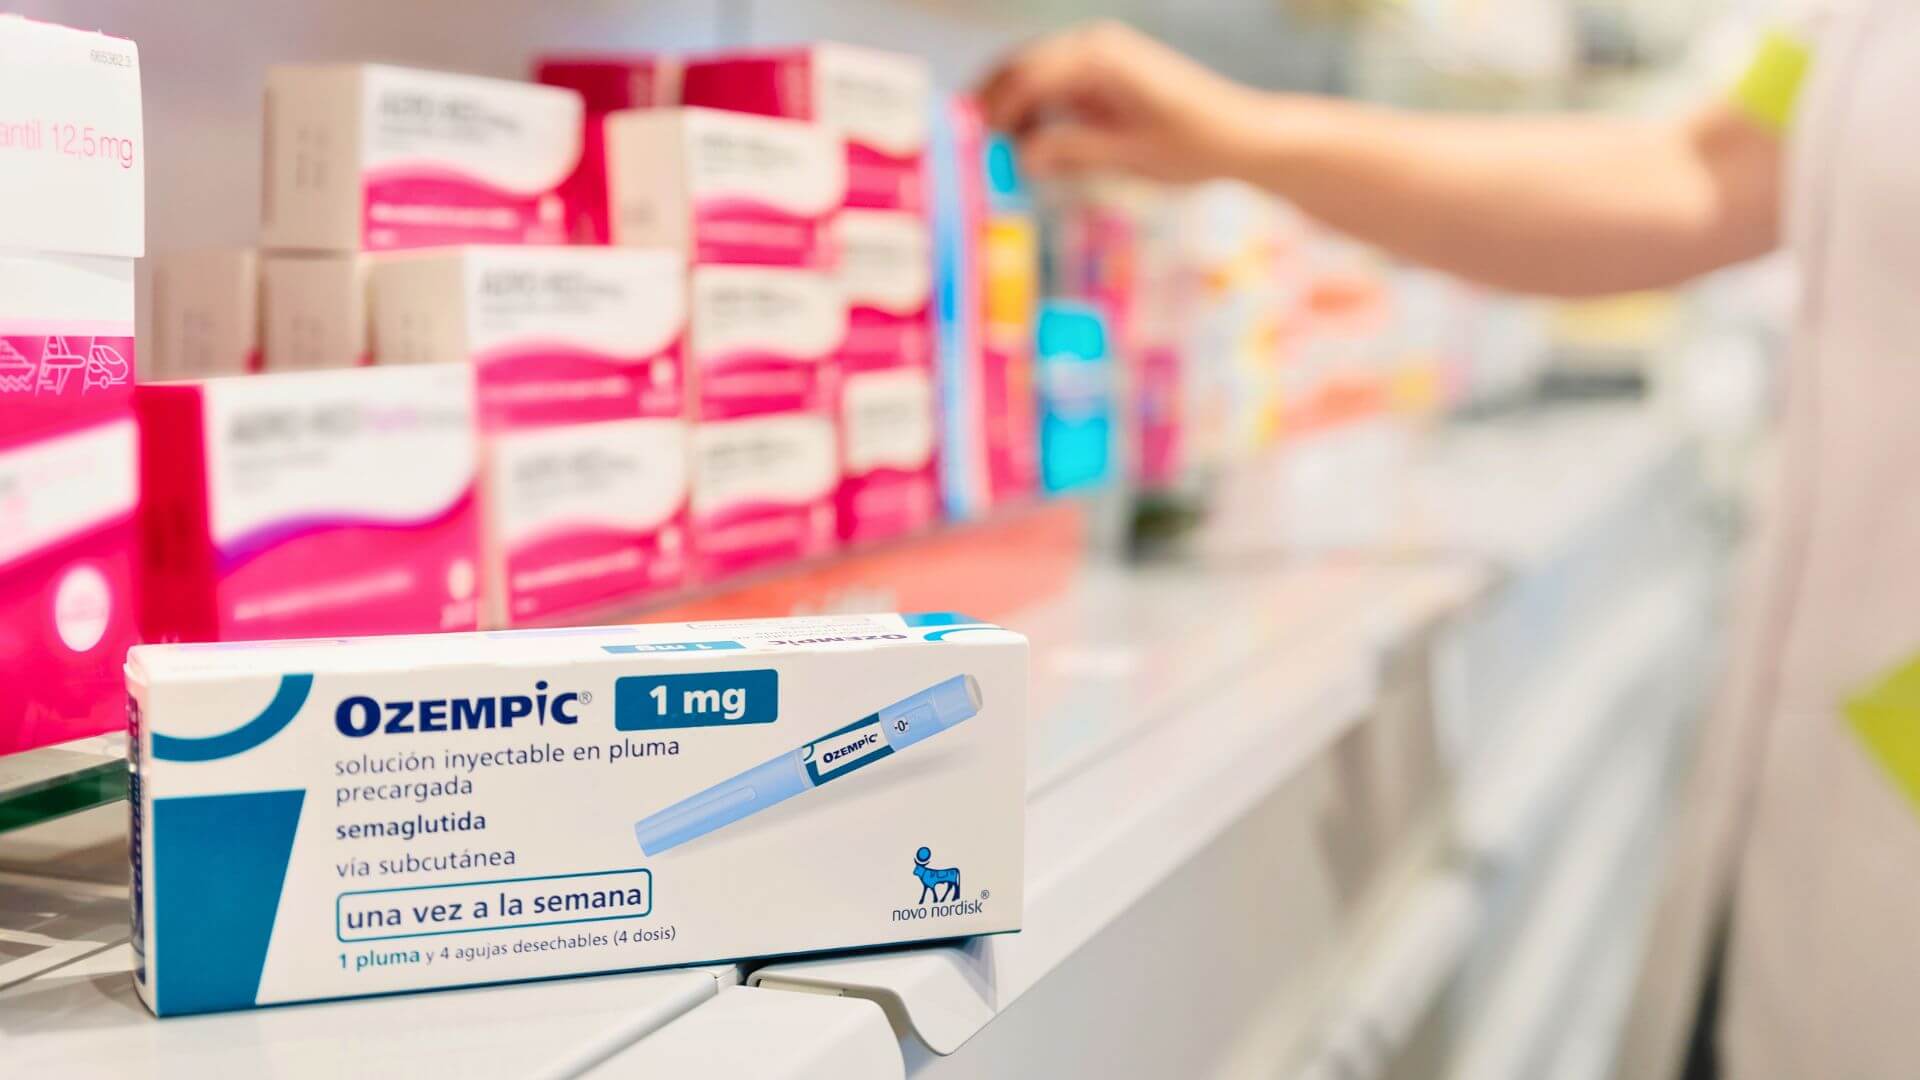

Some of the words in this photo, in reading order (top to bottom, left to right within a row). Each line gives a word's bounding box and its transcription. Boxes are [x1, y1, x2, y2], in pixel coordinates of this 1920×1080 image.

[648, 685, 668, 715] 1
[683, 688, 746, 719] mg
[335, 751, 435, 775] solución
[445, 742, 565, 772] inyectable
[573, 745, 600, 761] en
[609, 738, 680, 763] pluma
[336, 776, 473, 806] precargada
[336, 811, 486, 840] semaglutida
[336, 860, 370, 877] vía
[380, 849, 516, 874] subcutánea
[347, 907, 402, 929] una
[412, 903, 463, 924] vez
[473, 902, 488, 918] a
[500, 892, 523, 916] la
[533, 887, 642, 913] semana
[892, 907, 927, 921] novo
[338, 953, 348, 969] 1
[356, 948, 420, 972] pluma
[426, 950, 435, 964] y
[440, 946, 450, 960] 4
[455, 943, 508, 962] agujas
[513, 932, 609, 955] desechables
[613, 930, 628, 947] (4
[633, 925, 676, 943] dosis)
